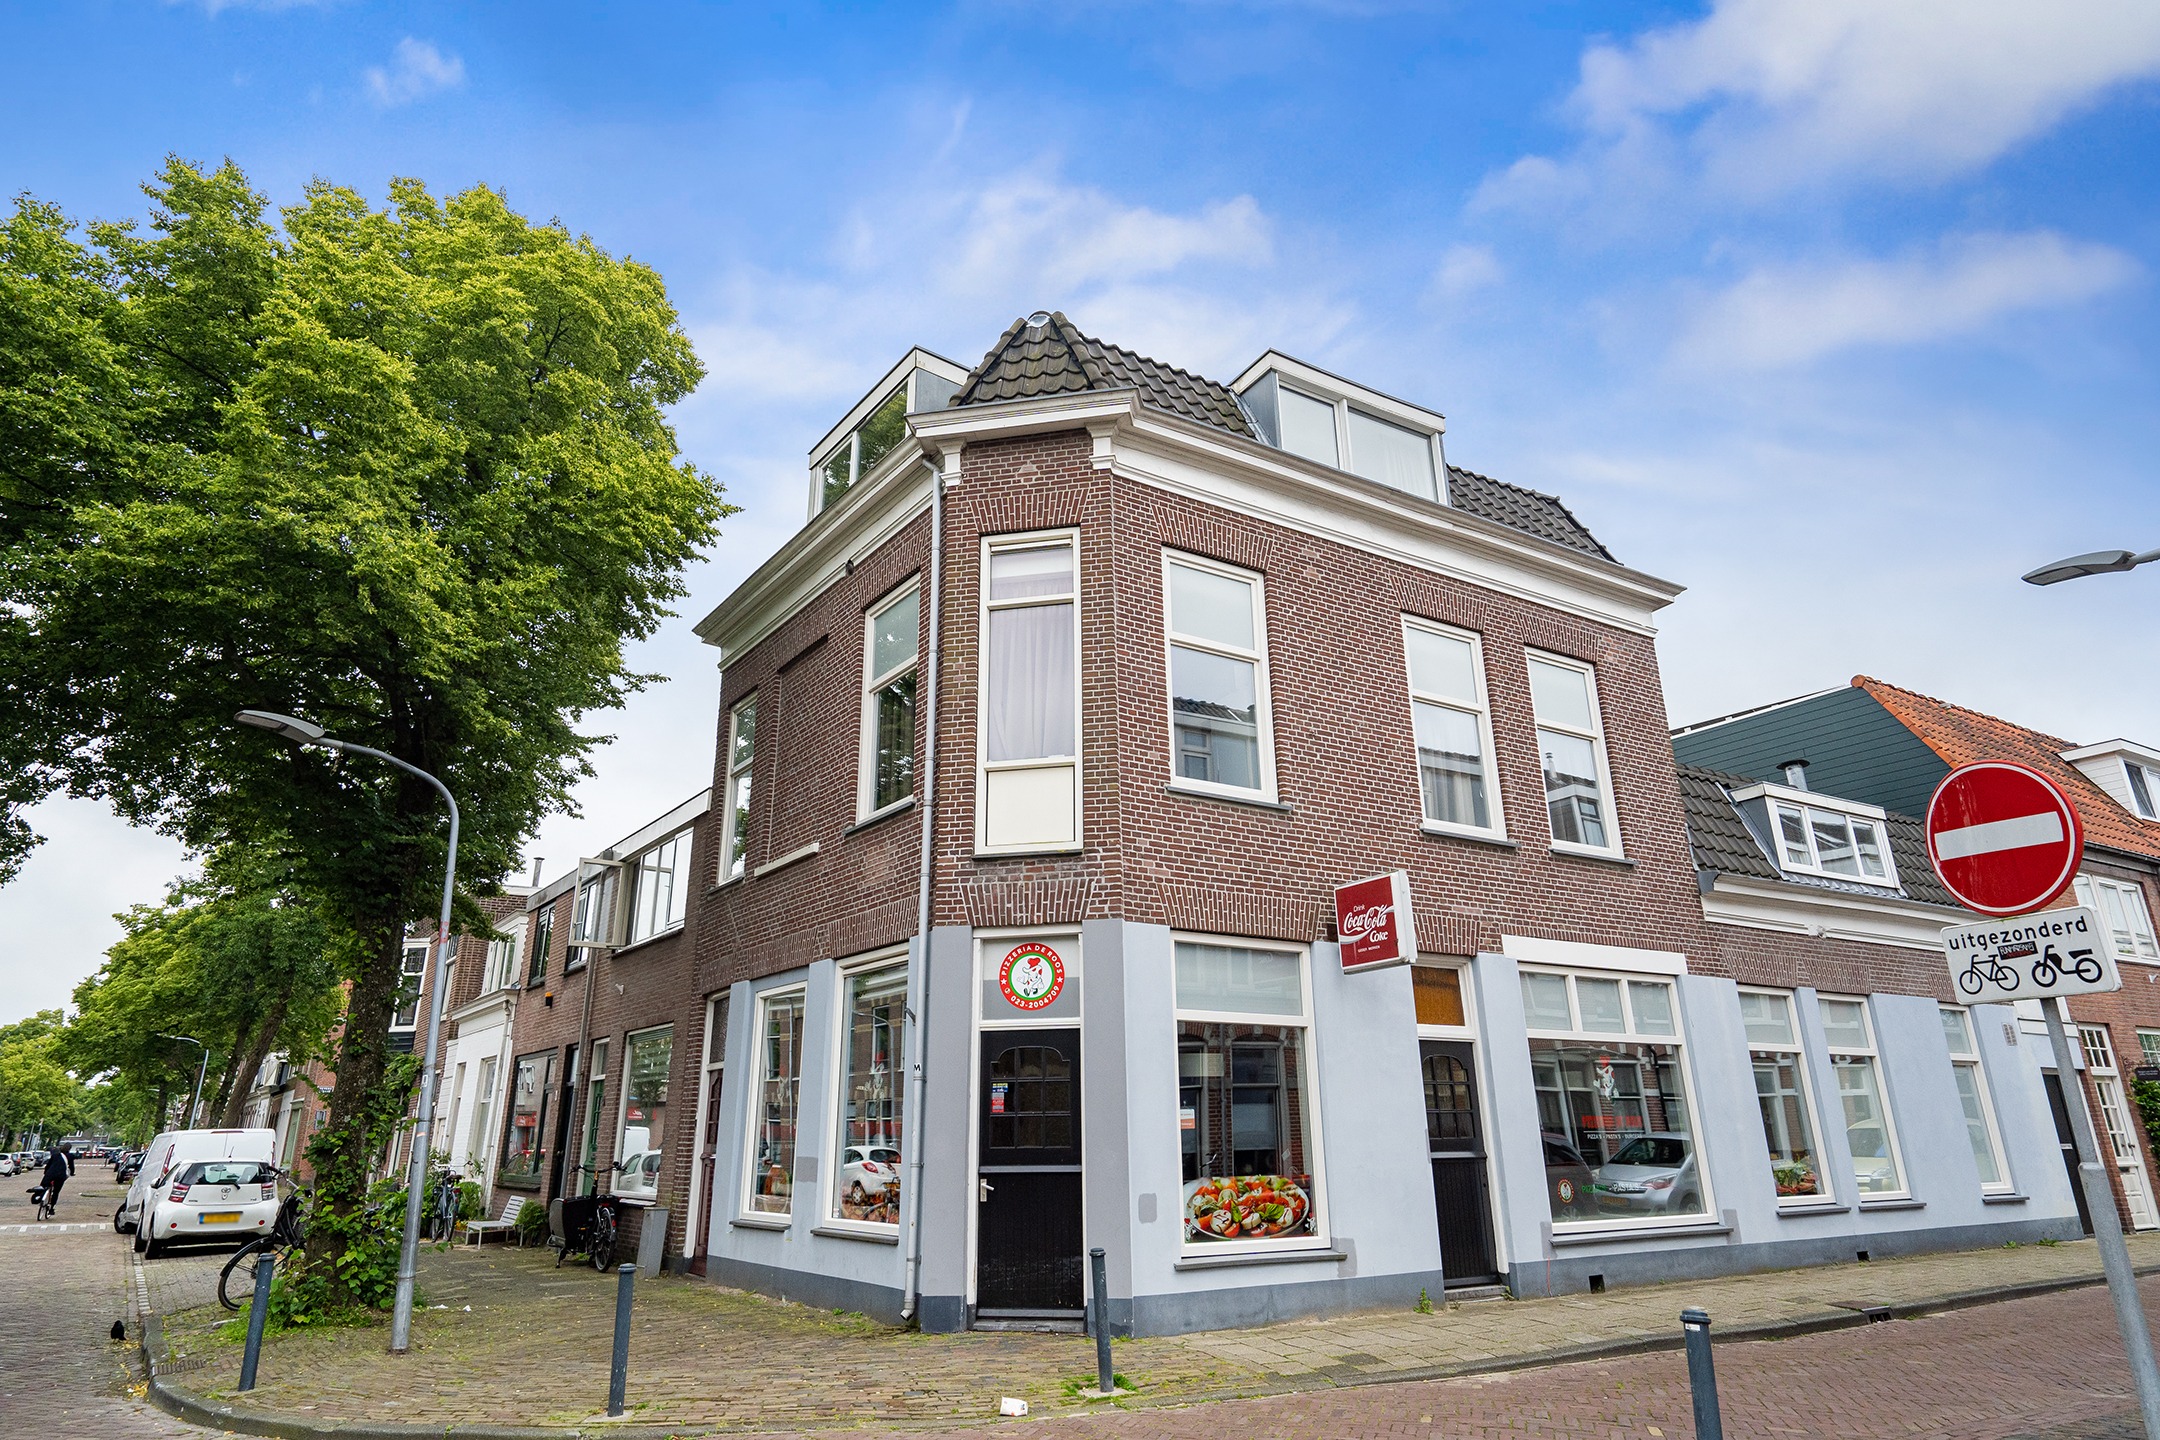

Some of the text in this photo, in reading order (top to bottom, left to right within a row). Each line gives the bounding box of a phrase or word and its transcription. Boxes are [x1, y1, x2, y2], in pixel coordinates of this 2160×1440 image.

[1370, 931, 1388, 942] Coke
[1948, 915, 2089, 951] uitgezonderd
[1002, 945, 1063, 976] PIZZERIA DE ROOS
[1010, 985, 1060, 1009] 023-2004709
